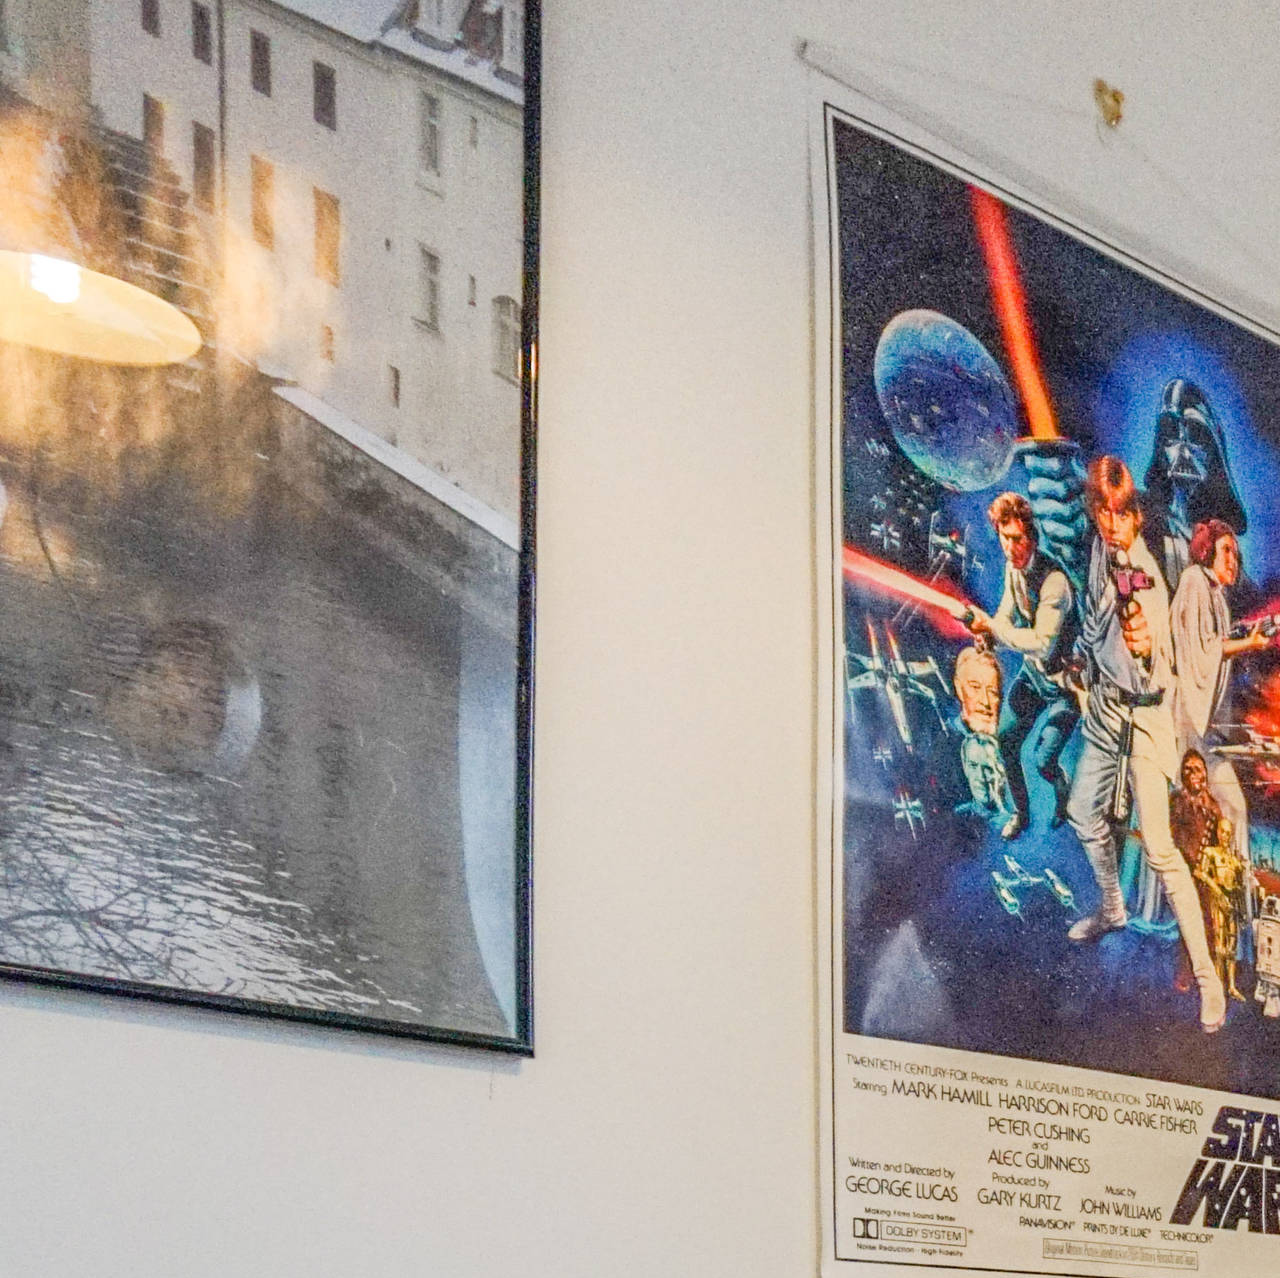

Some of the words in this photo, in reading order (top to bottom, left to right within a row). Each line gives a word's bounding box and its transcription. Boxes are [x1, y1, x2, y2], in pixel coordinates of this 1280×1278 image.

[846, 1053, 900, 1072] TWENTIETH
[904, 1062, 968, 1080] CENTURY-FOX
[971, 1071, 1008, 1087] Presents
[1087, 1088, 1140, 1105] PRODUCTION
[1145, 1093, 1171, 1111] STAR
[1174, 1098, 1204, 1116] WARS
[852, 1077, 887, 1096] Starring
[891, 1079, 937, 1100] MARK
[940, 1084, 992, 1107] HAMILL
[999, 1092, 1069, 1117] HARRISON
[1072, 1102, 1108, 1122] FORD
[1114, 1108, 1157, 1130] CARRIE
[1160, 1115, 1198, 1135] FISHER
[988, 1116, 1031, 1136] PETER
[1034, 1122, 1090, 1144] CUSHING
[1032, 1142, 1048, 1151] and
[848, 1156, 881, 1171] Written
[883, 1162, 901, 1174] and
[904, 1163, 941, 1178] Directed
[943, 1167, 956, 1181] by
[988, 1149, 1022, 1168] ALEC
[1025, 1152, 1090, 1174] GUINNESS
[845, 1175, 912, 1198] GEORGE
[916, 1182, 958, 1202] LUCAS
[991, 1172, 1036, 1187] Produced
[1039, 1177, 1050, 1189] by
[1105, 1185, 1126, 1196] Music
[1127, 1187, 1137, 1198] by
[977, 1188, 1016, 1206] GARY
[1020, 1192, 1062, 1211] KURTZ
[1079, 1198, 1110, 1216] JOHN
[1112, 1201, 1162, 1221] WILLIAMS
[885, 1225, 919, 1238] DOLBY
[921, 1228, 962, 1241] SYSTEM
